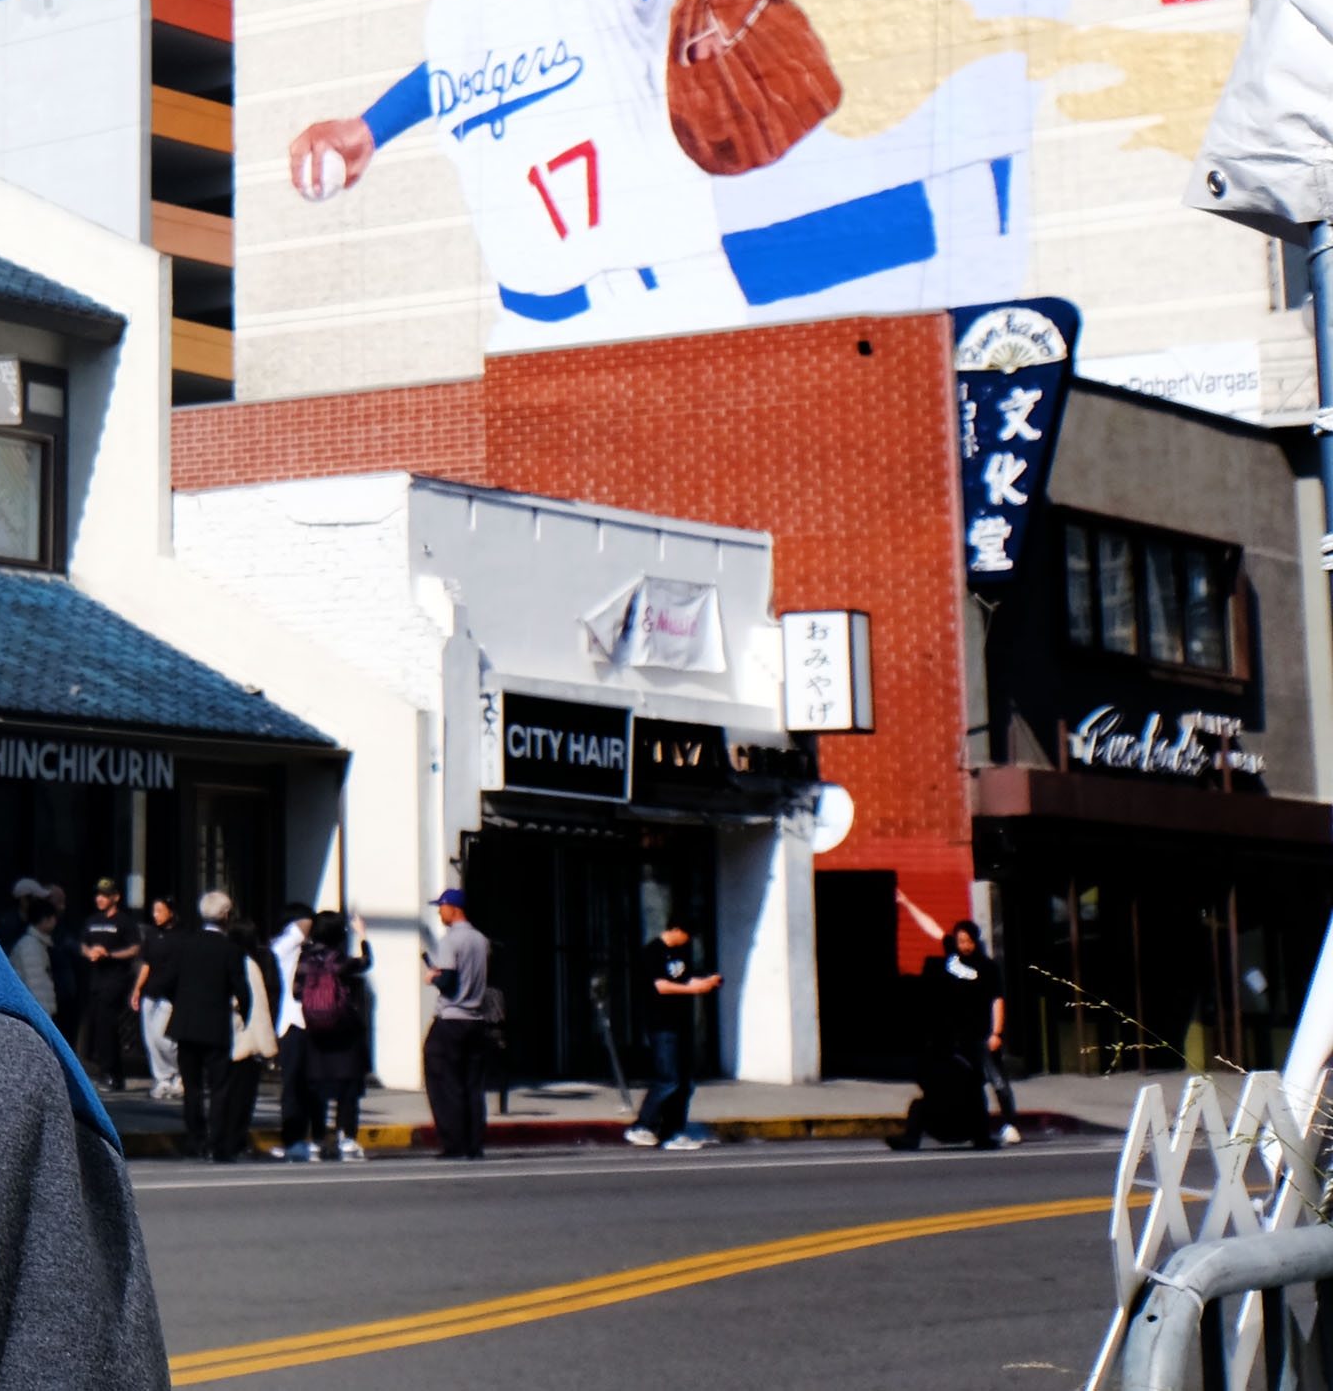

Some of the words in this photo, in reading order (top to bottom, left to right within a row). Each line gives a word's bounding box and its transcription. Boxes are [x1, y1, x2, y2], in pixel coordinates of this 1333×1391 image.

[429, 39, 573, 140] Dodgers
[527, 138, 600, 242] 17
[967, 385, 1044, 573] 文化堂
[803, 619, 835, 725] おみやげ
[506, 723, 565, 763] CITY
[567, 733, 626, 770] HAIR
